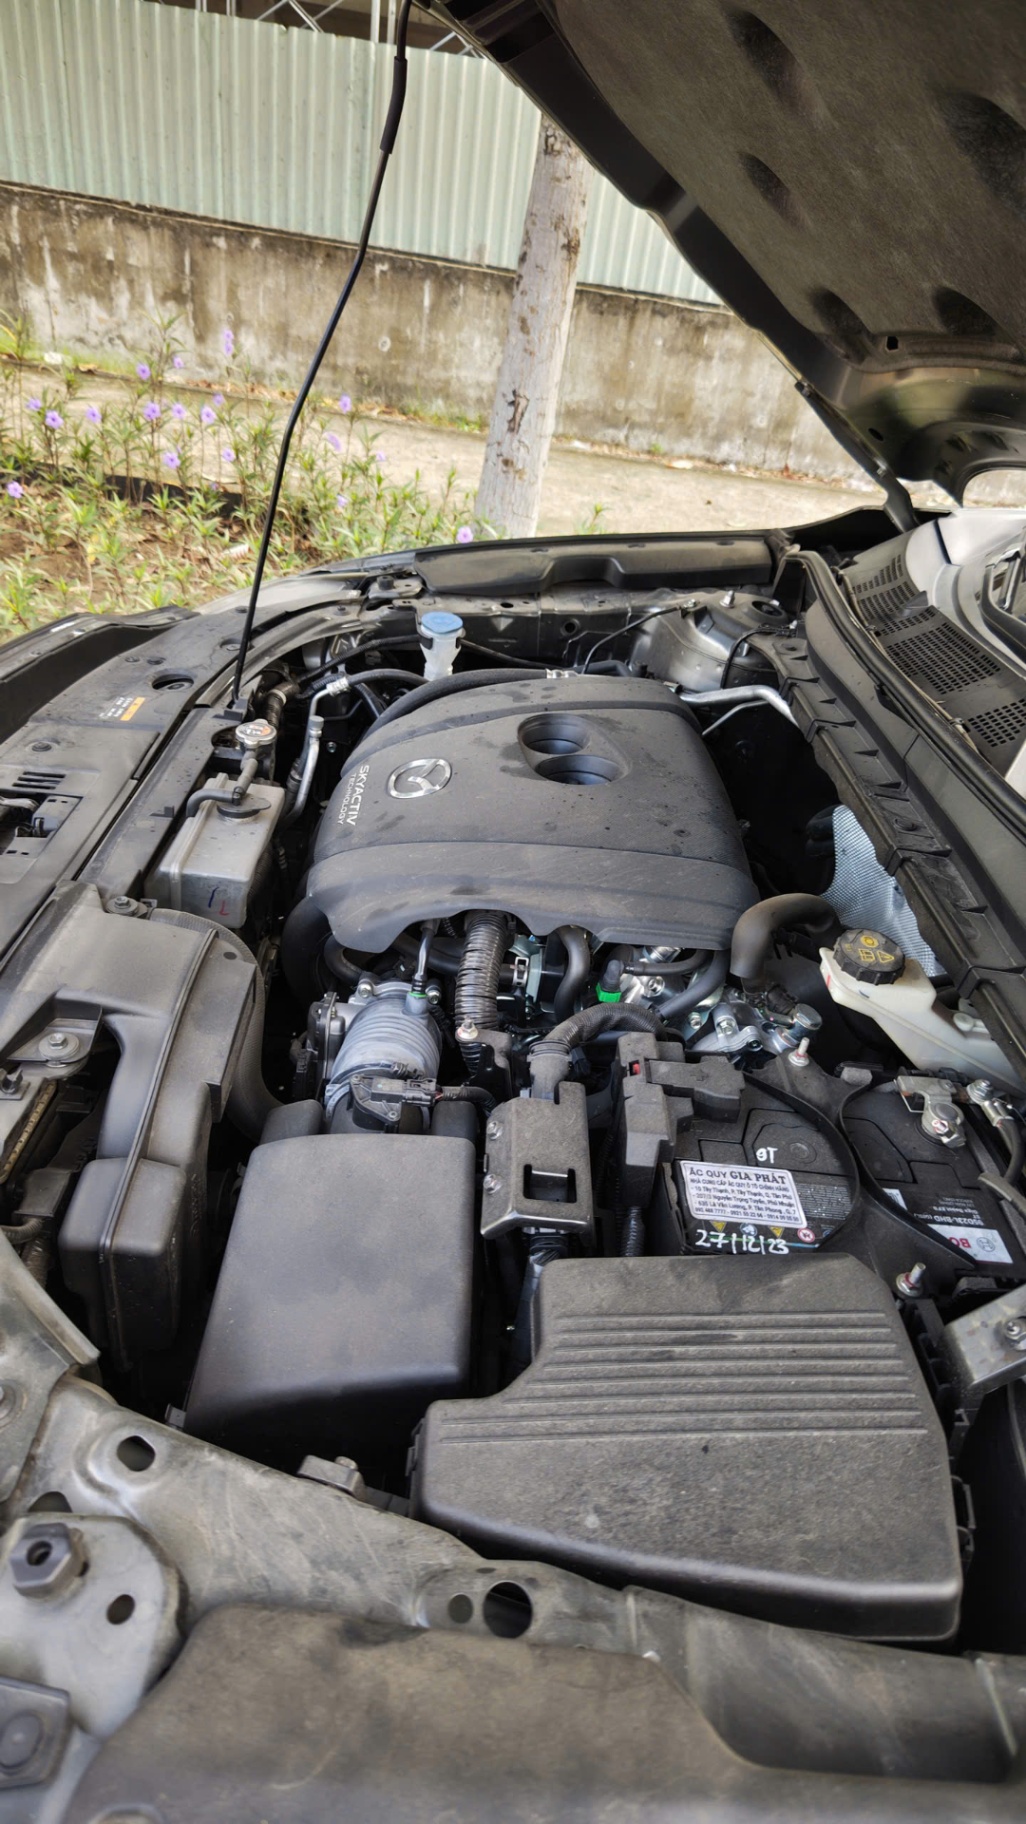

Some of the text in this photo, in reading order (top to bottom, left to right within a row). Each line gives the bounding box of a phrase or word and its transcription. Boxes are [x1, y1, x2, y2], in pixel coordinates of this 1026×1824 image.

[337, 773, 357, 825] TECHNOLOGY
[346, 764, 370, 826] SKYACTIV
[706, 1170, 727, 1178] QUY
[730, 1171, 751, 1181] GIA
[754, 1173, 786, 1184] PHÁT
